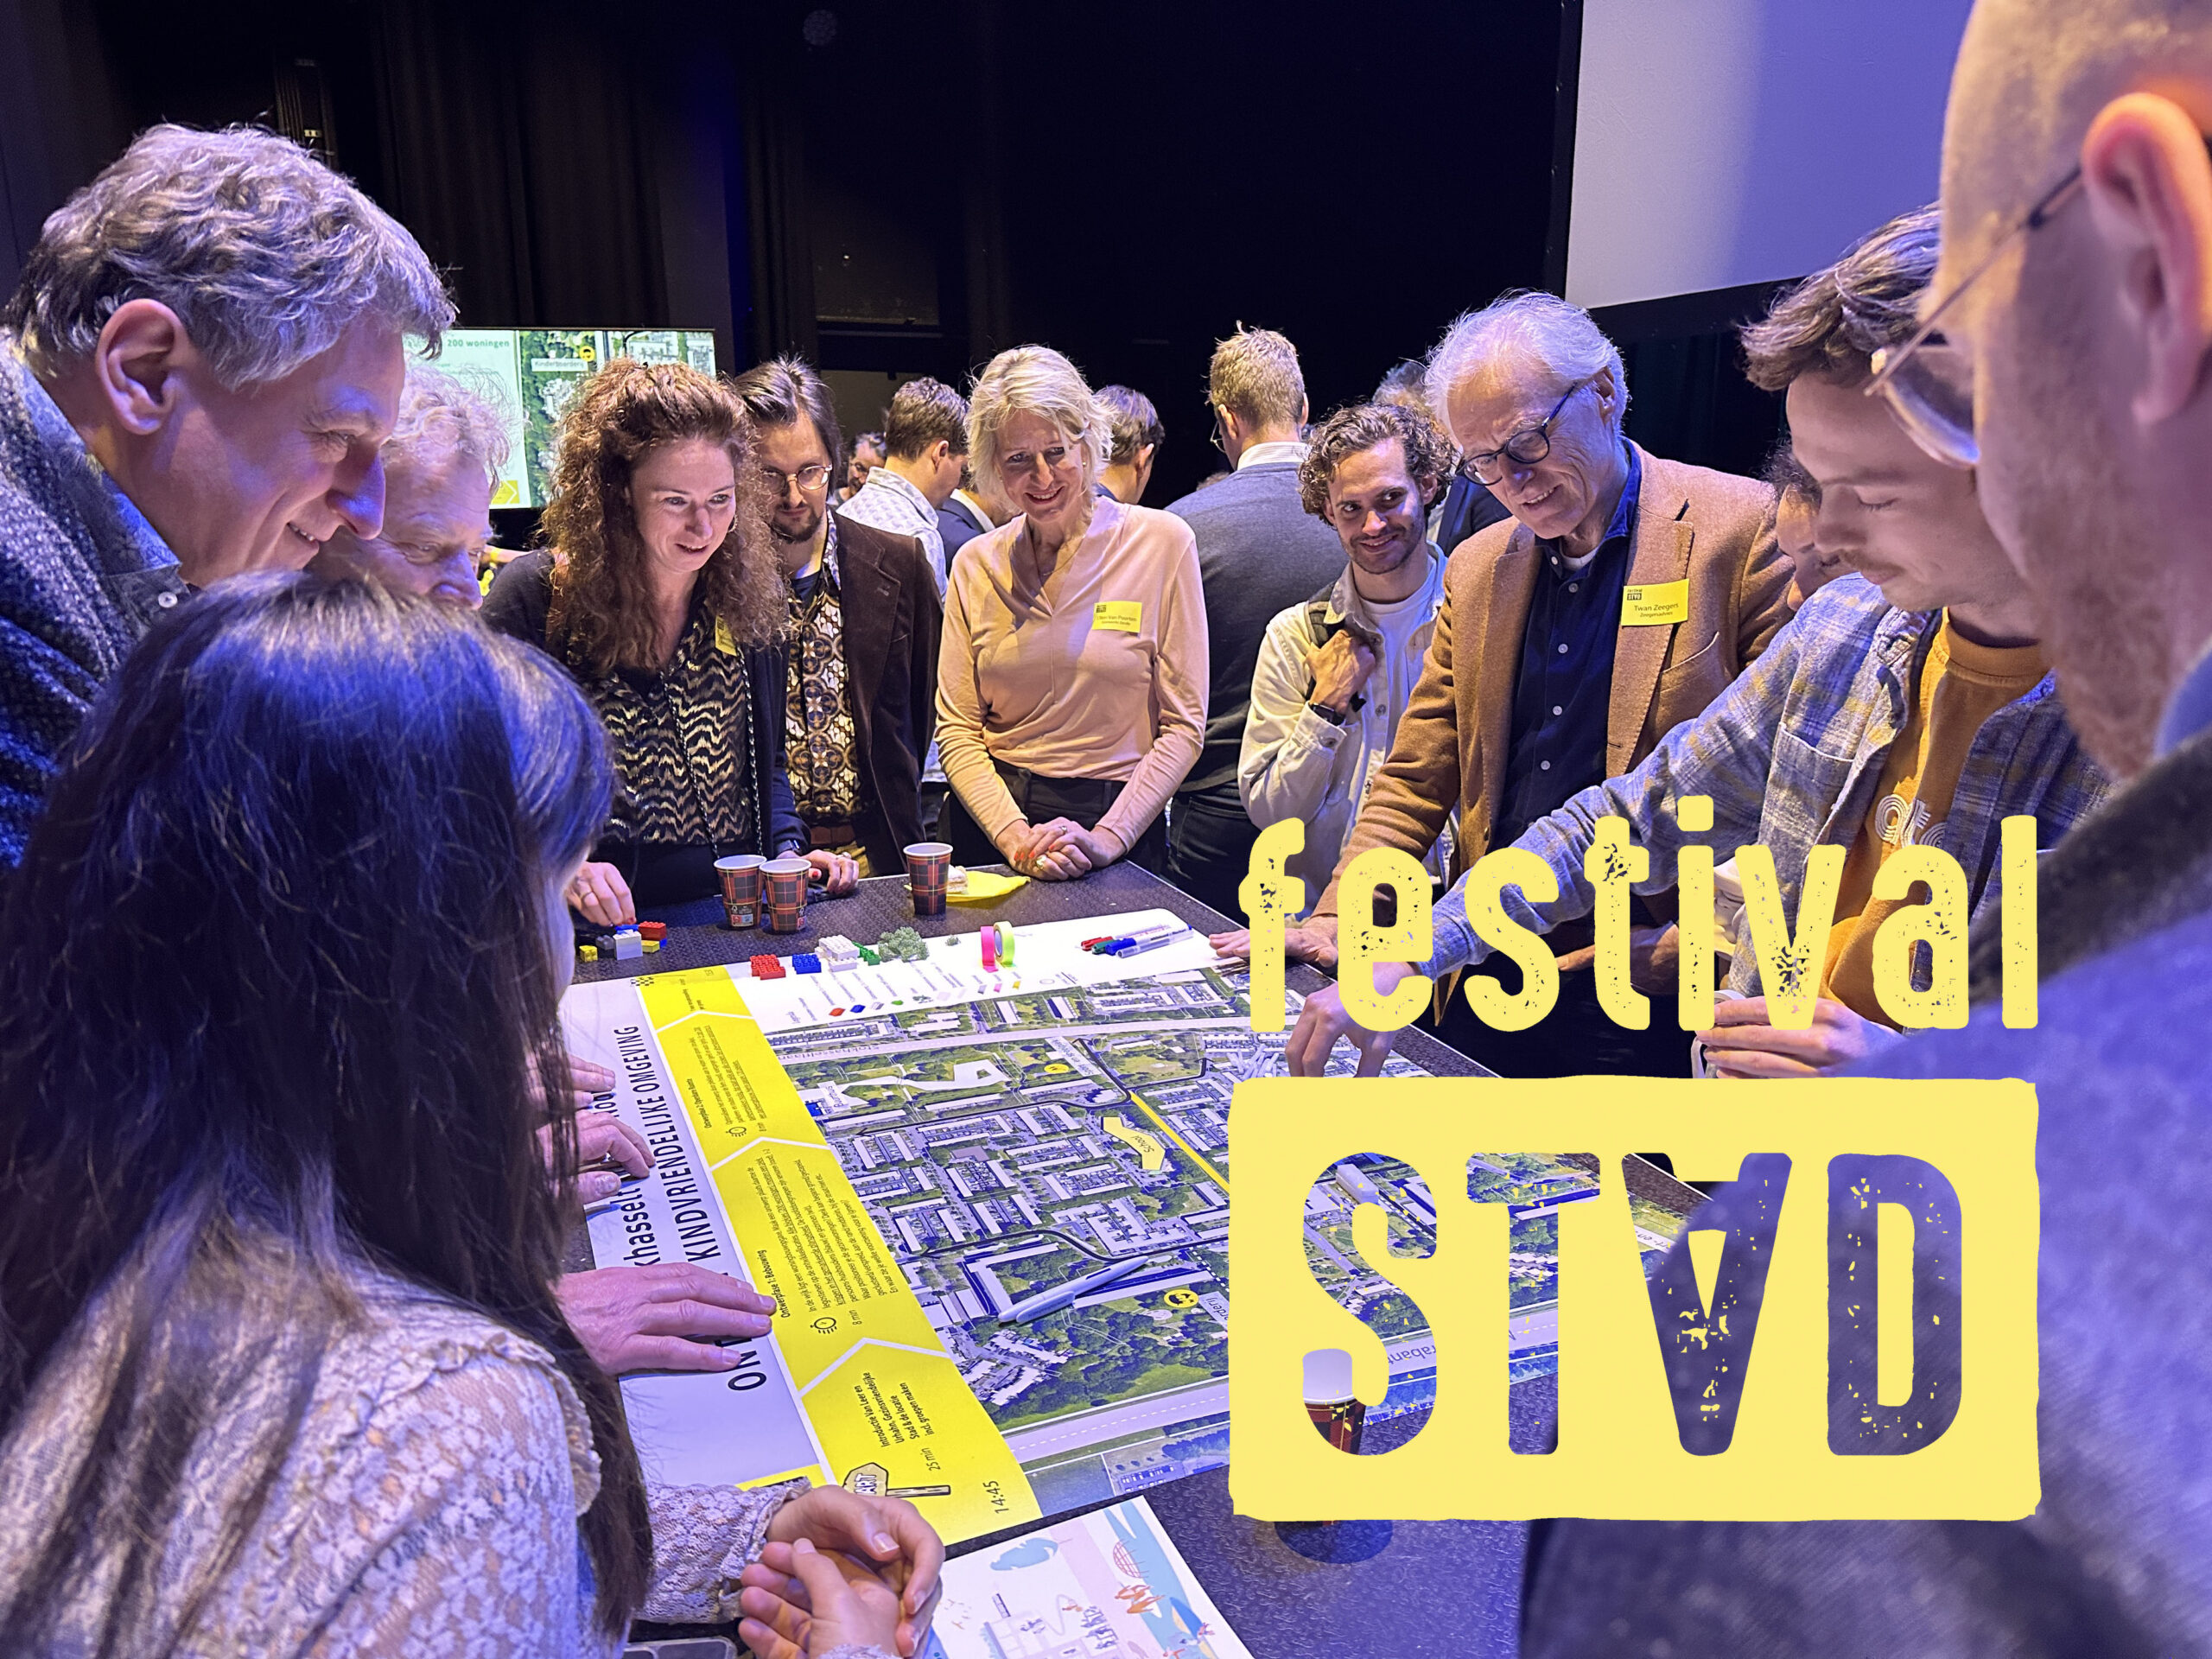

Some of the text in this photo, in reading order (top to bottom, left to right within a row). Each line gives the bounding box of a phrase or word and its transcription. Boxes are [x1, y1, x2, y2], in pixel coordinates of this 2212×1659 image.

[466, 339, 510, 347] woningen
[614, 1027, 660, 1092] OMGEVING
[638, 1096, 721, 1262] KINDVRIENDELIJKE
[758, 1250, 774, 1278] Bebouwing
[772, 1284, 791, 1318] Ontwerpfase
[858, 1394, 868, 1406] Leer
[863, 1372, 893, 1421] Gezinsvriendelijke
[891, 1395, 905, 1414] locatie
[899, 1382, 934, 1436] incl. groepen maken
[861, 1405, 874, 1417] Van
[866, 1416, 890, 1447] Introductie
[905, 1426, 919, 1439] Stad
[921, 1448, 940, 1471] 25 min
[855, 1473, 877, 1494] ART
[982, 1480, 1009, 1514] 14:45
